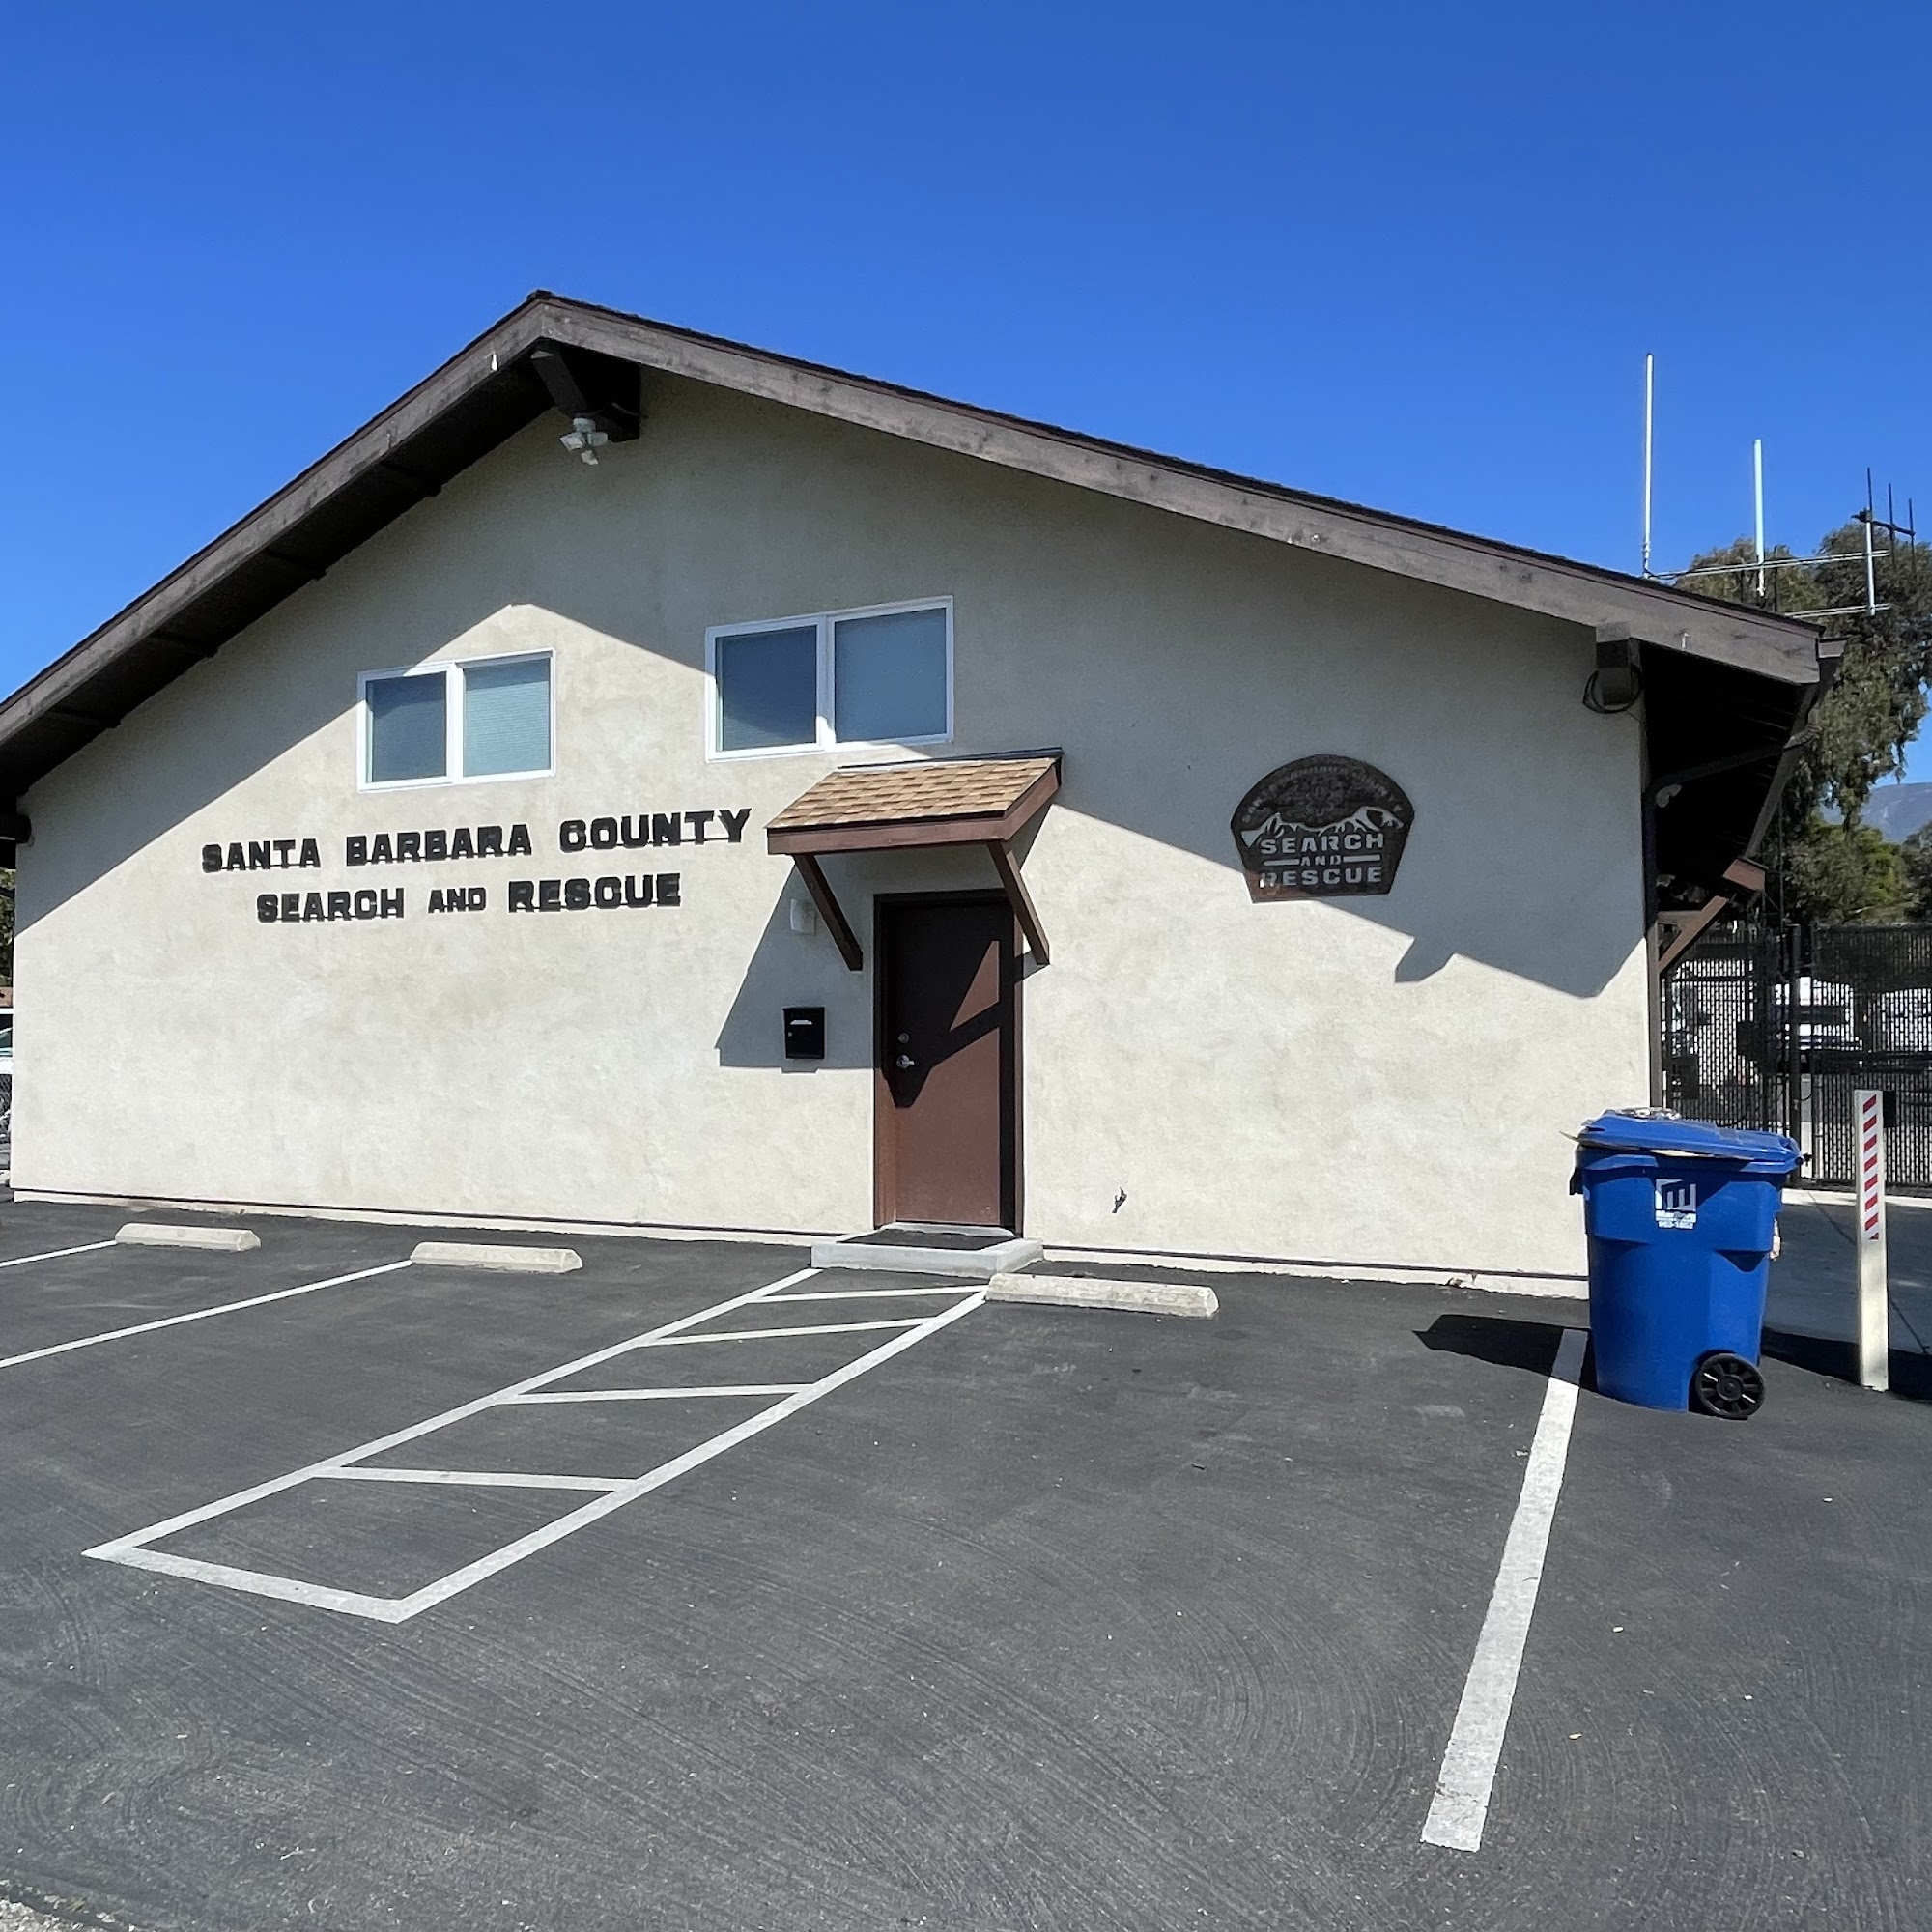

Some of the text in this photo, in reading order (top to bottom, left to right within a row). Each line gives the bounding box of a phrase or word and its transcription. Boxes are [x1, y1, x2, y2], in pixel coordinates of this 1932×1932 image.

[202, 808, 752, 874] SANTA BARBARA COUNTY
[1261, 833, 1384, 854] SEARCH
[1299, 855, 1341, 867] AND
[1259, 867, 1382, 888] RESCUE
[257, 873, 681, 923] SEARCH AND RESCUE
